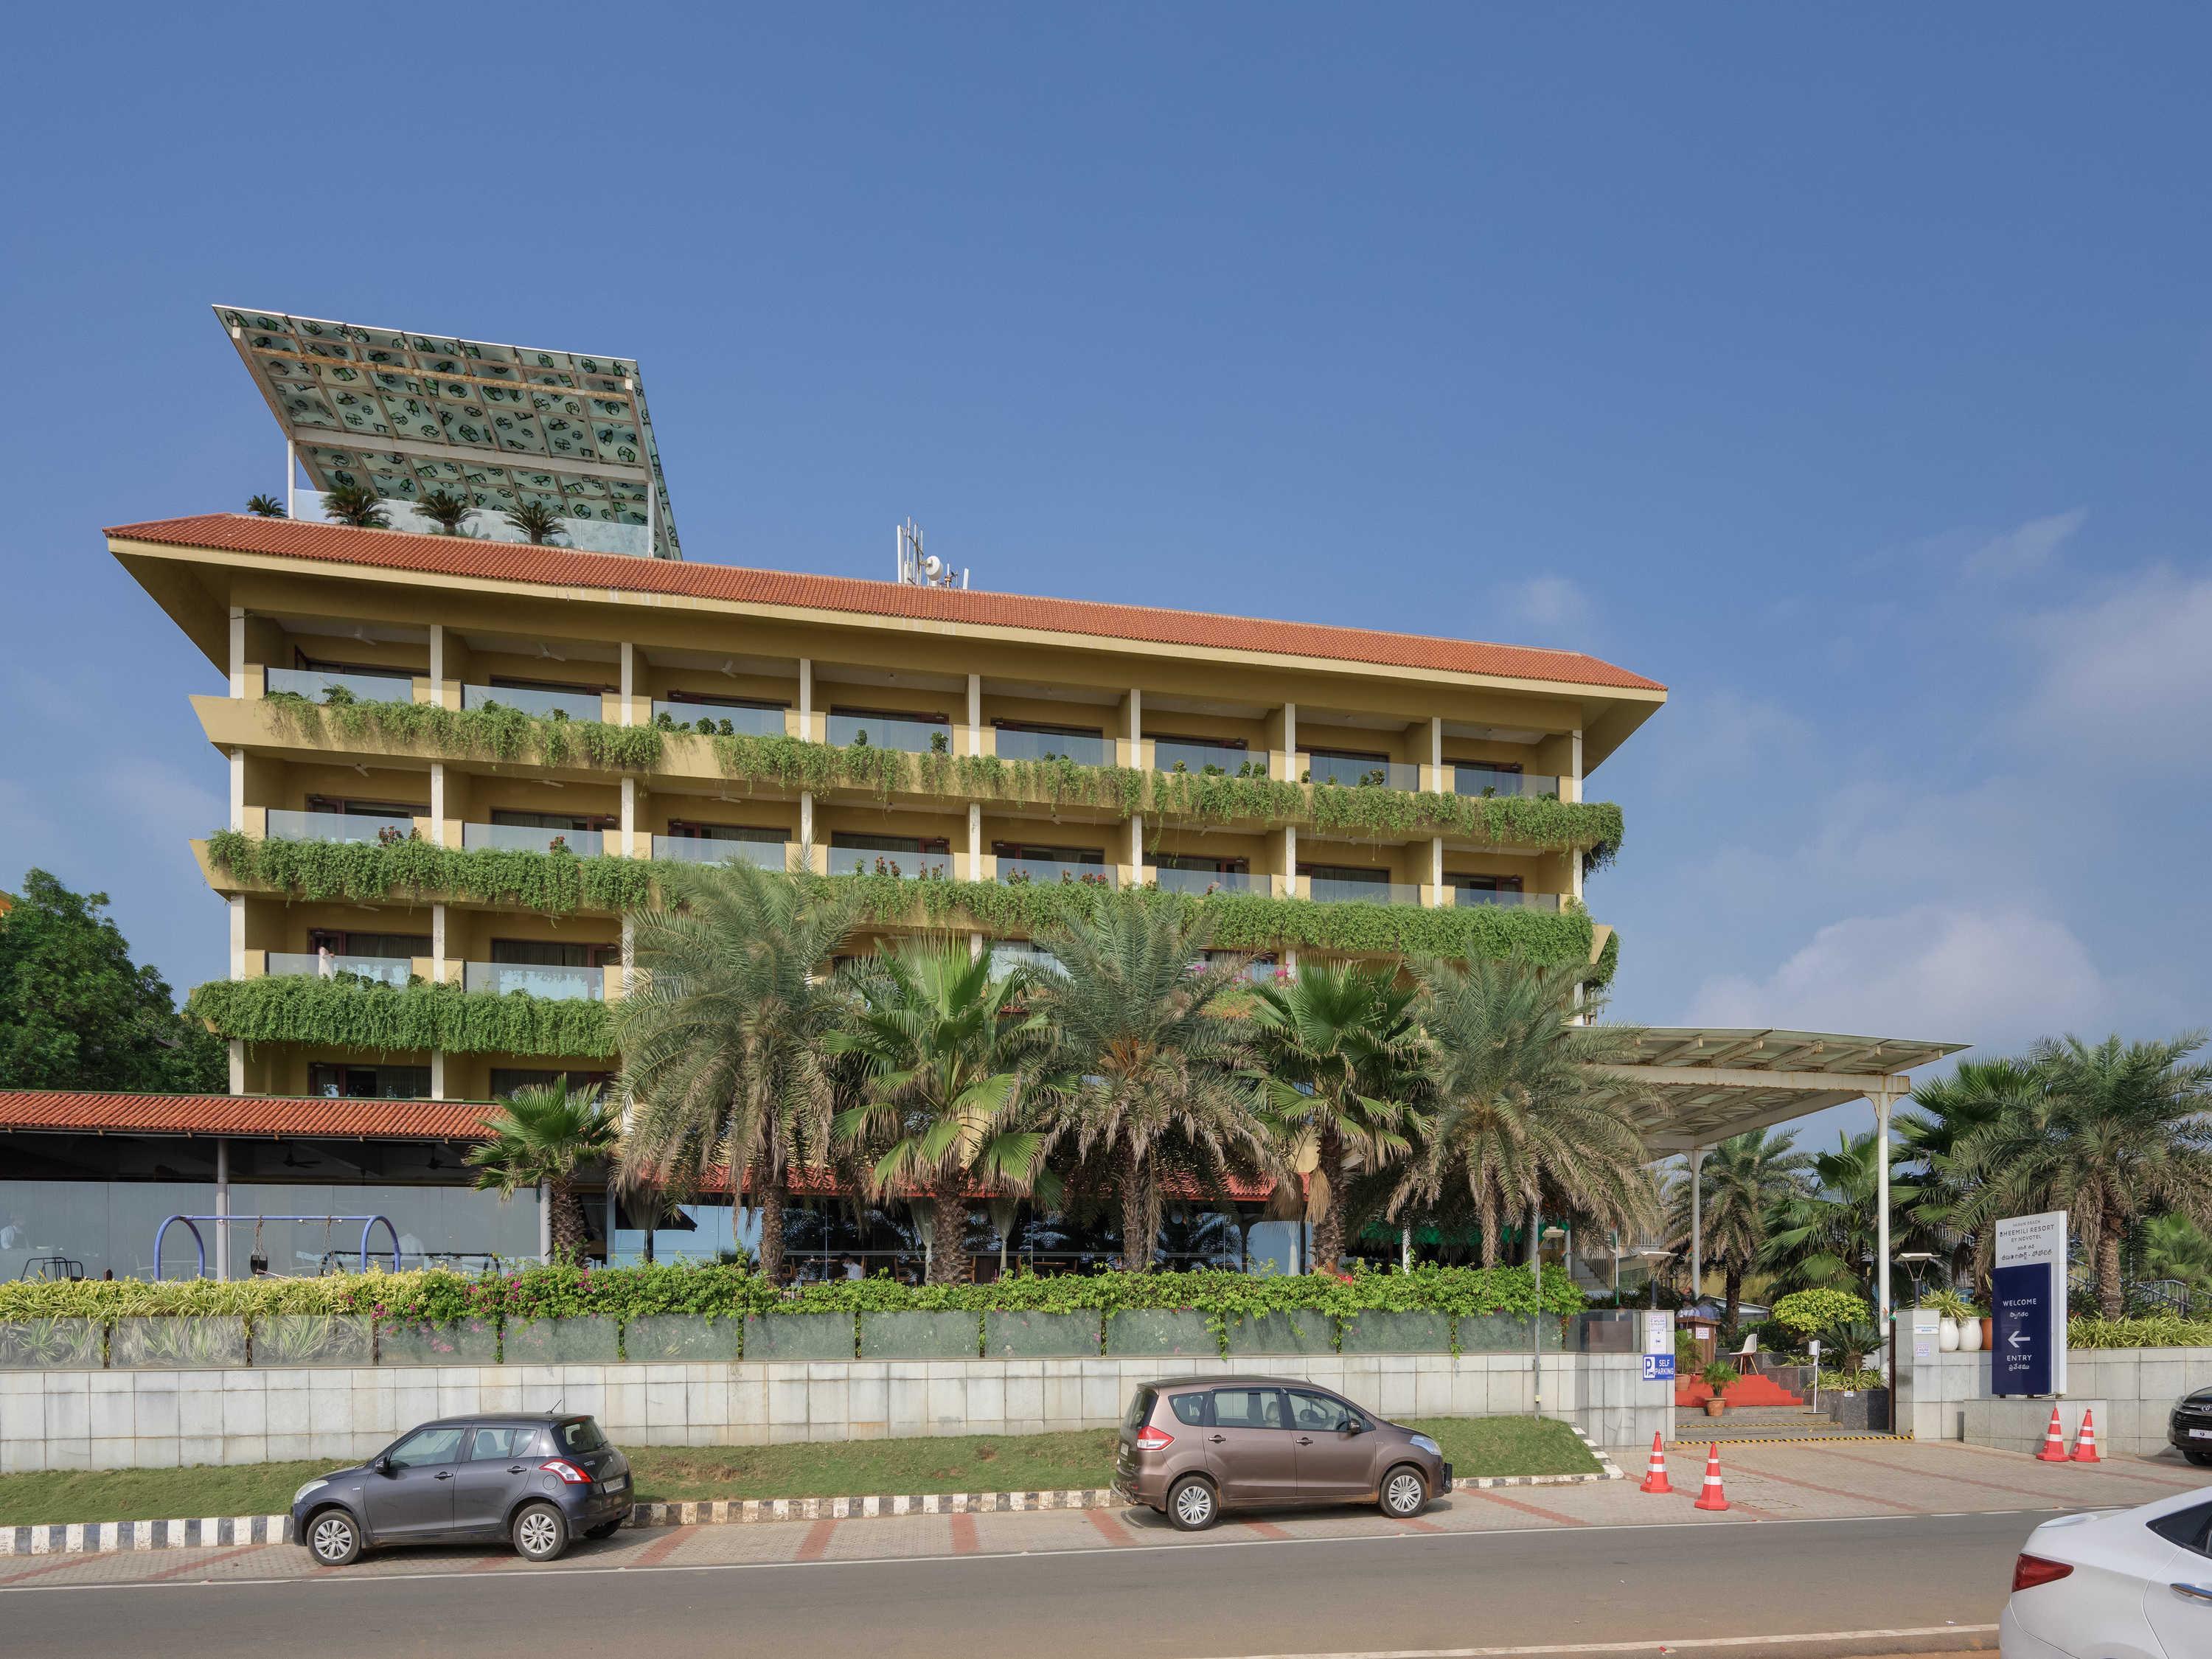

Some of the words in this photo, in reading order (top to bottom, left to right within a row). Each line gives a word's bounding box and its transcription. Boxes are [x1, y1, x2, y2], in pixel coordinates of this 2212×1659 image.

[2000, 1228, 2028, 1237] BHEEMILI
[2030, 1224, 2055, 1233] RESORT
[2003, 1298, 2037, 1307] WELCOME
[1645, 1358, 1652, 1376] P
